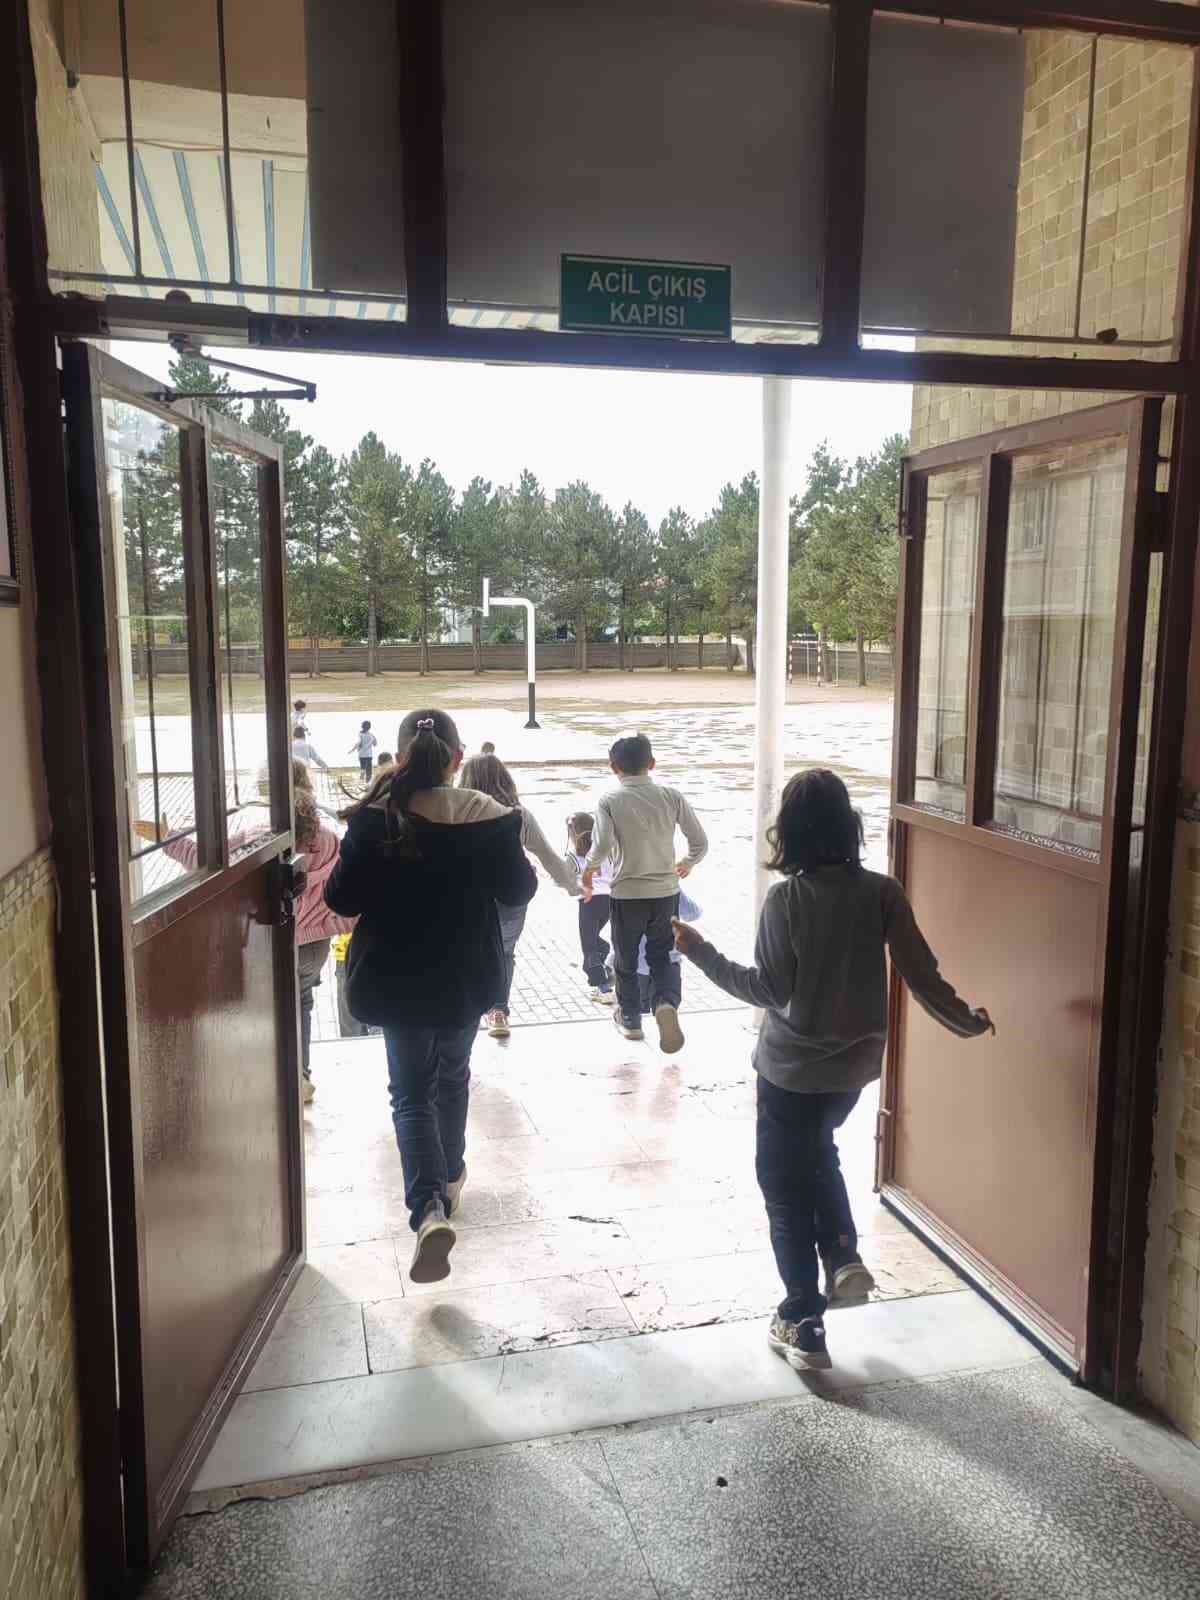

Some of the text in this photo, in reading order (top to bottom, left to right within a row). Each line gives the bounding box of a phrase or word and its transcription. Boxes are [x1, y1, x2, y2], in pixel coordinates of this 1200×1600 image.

[587, 267, 706, 303] ACİL ÇIKIŞ
[609, 302, 686, 327] KAPISI
